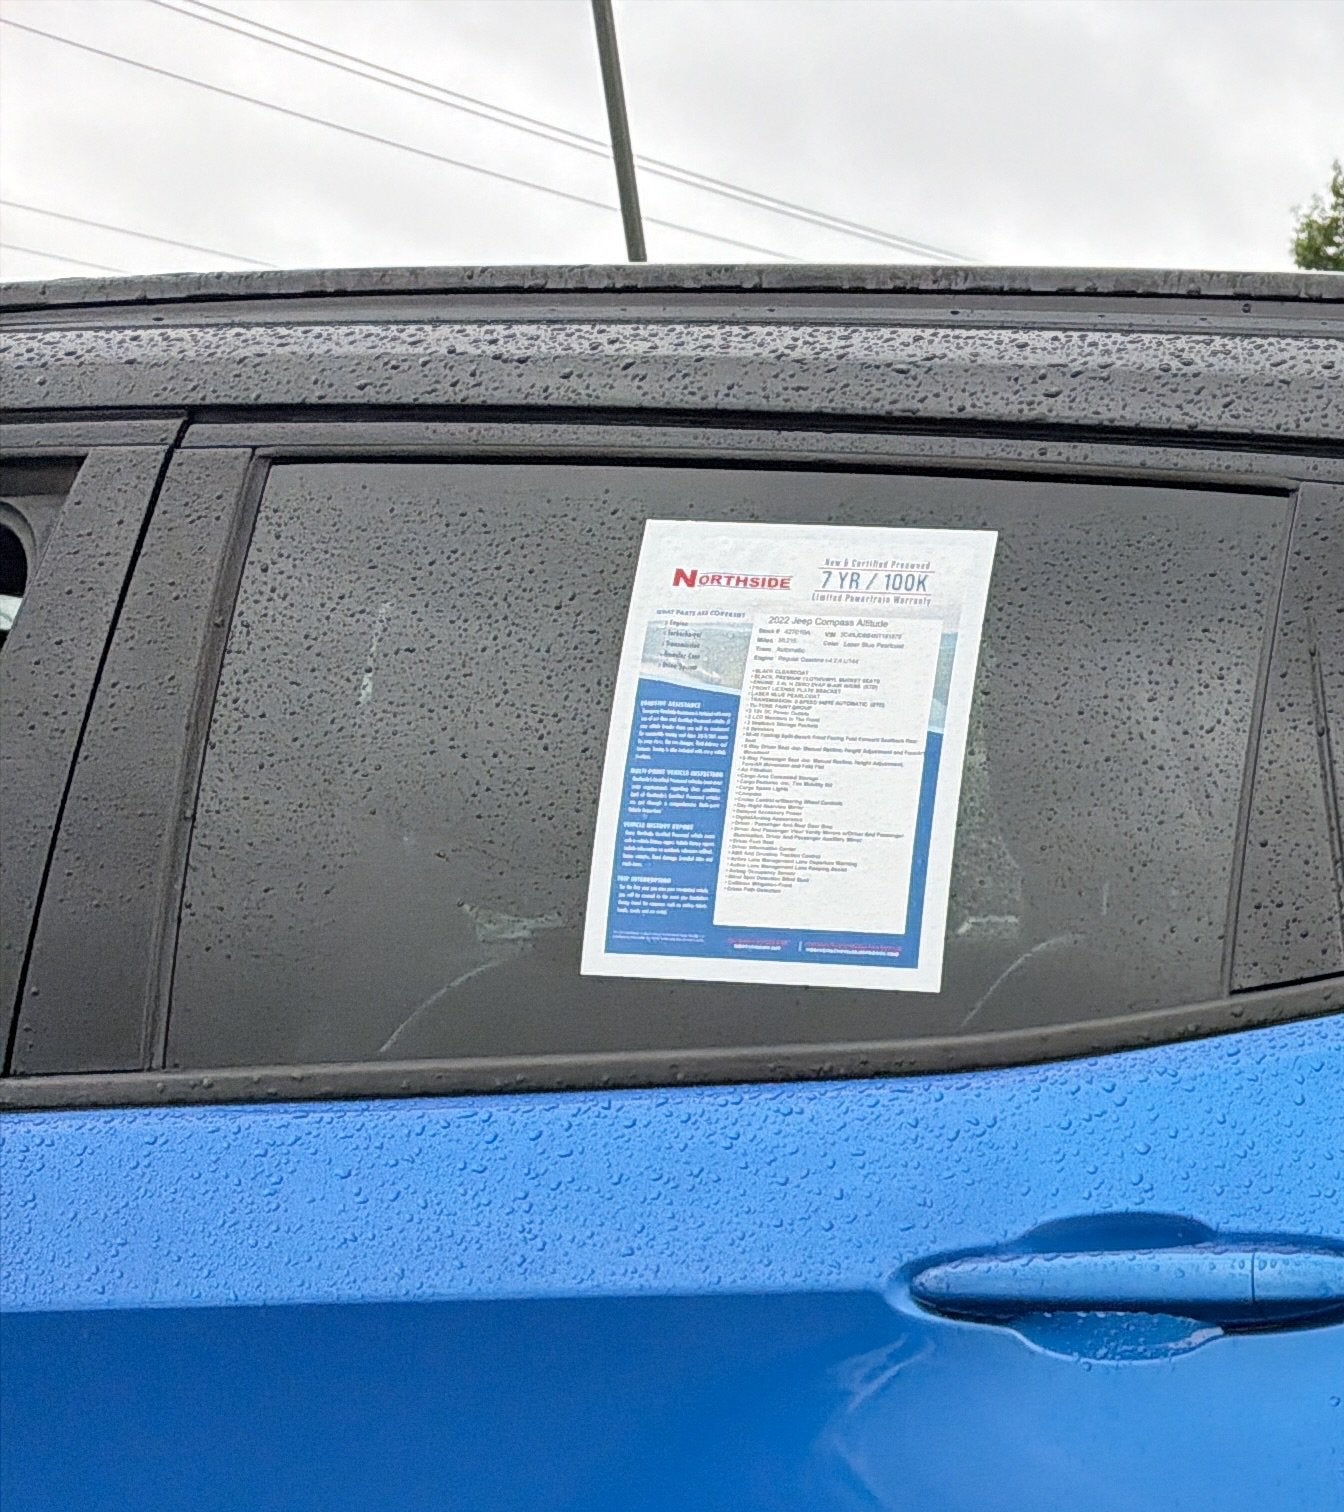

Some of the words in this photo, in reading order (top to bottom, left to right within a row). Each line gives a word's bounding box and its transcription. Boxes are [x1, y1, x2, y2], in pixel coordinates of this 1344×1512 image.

[824, 558, 840, 567] New
[851, 559, 888, 569] Certified
[672, 567, 792, 590] NORTHSIDE
[821, 570, 833, 589] 7
[838, 571, 861, 590] YR
[884, 573, 929, 592] 100K
[811, 592, 843, 602] Limited
[844, 593, 891, 604] Powertrain
[893, 595, 932, 607] Warranty
[768, 615, 790, 625] 2022
[791, 616, 813, 627] Jeep
[814, 617, 855, 628] Compass
[856, 618, 889, 628] Altitude
